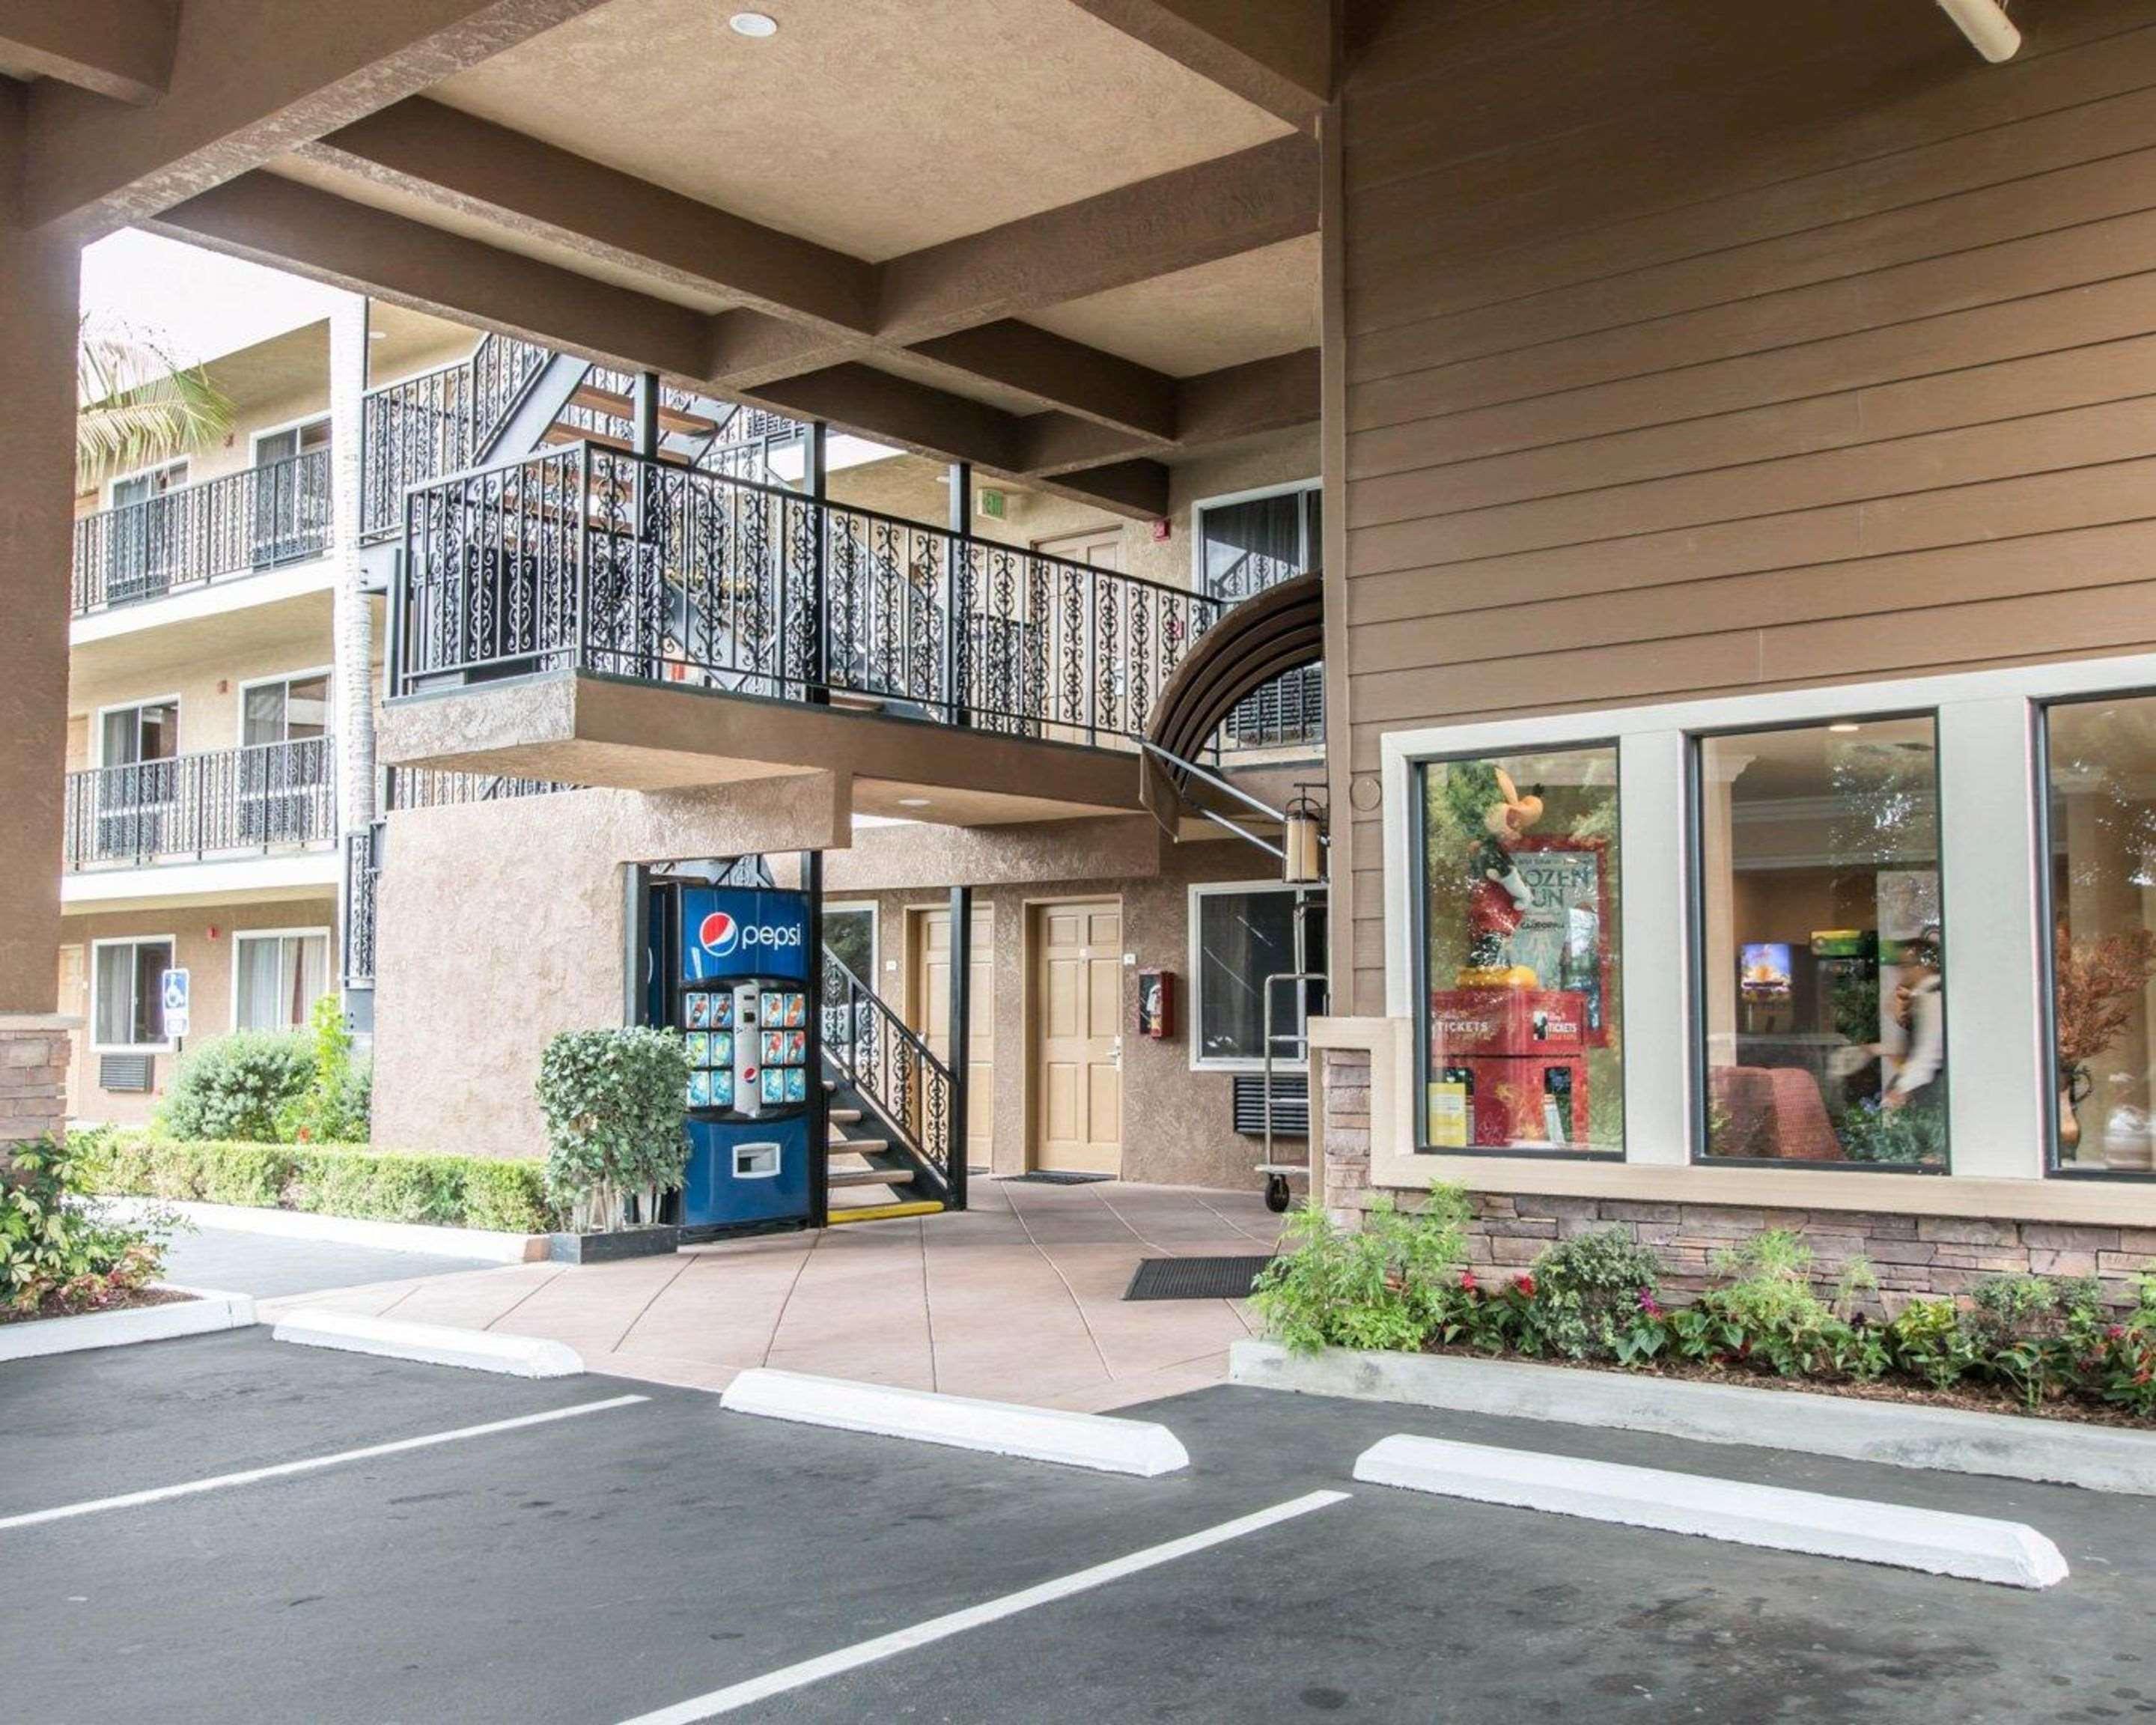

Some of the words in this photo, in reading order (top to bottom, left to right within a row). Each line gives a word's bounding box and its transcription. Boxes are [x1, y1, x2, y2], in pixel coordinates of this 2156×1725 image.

[1525, 868, 1589, 887] OZEN
[1531, 888, 1563, 907] UN
[743, 923, 800, 950] pepsi
[1435, 1020, 1489, 1032] TICKETS
[1547, 1023, 1577, 1032] TICKETS
